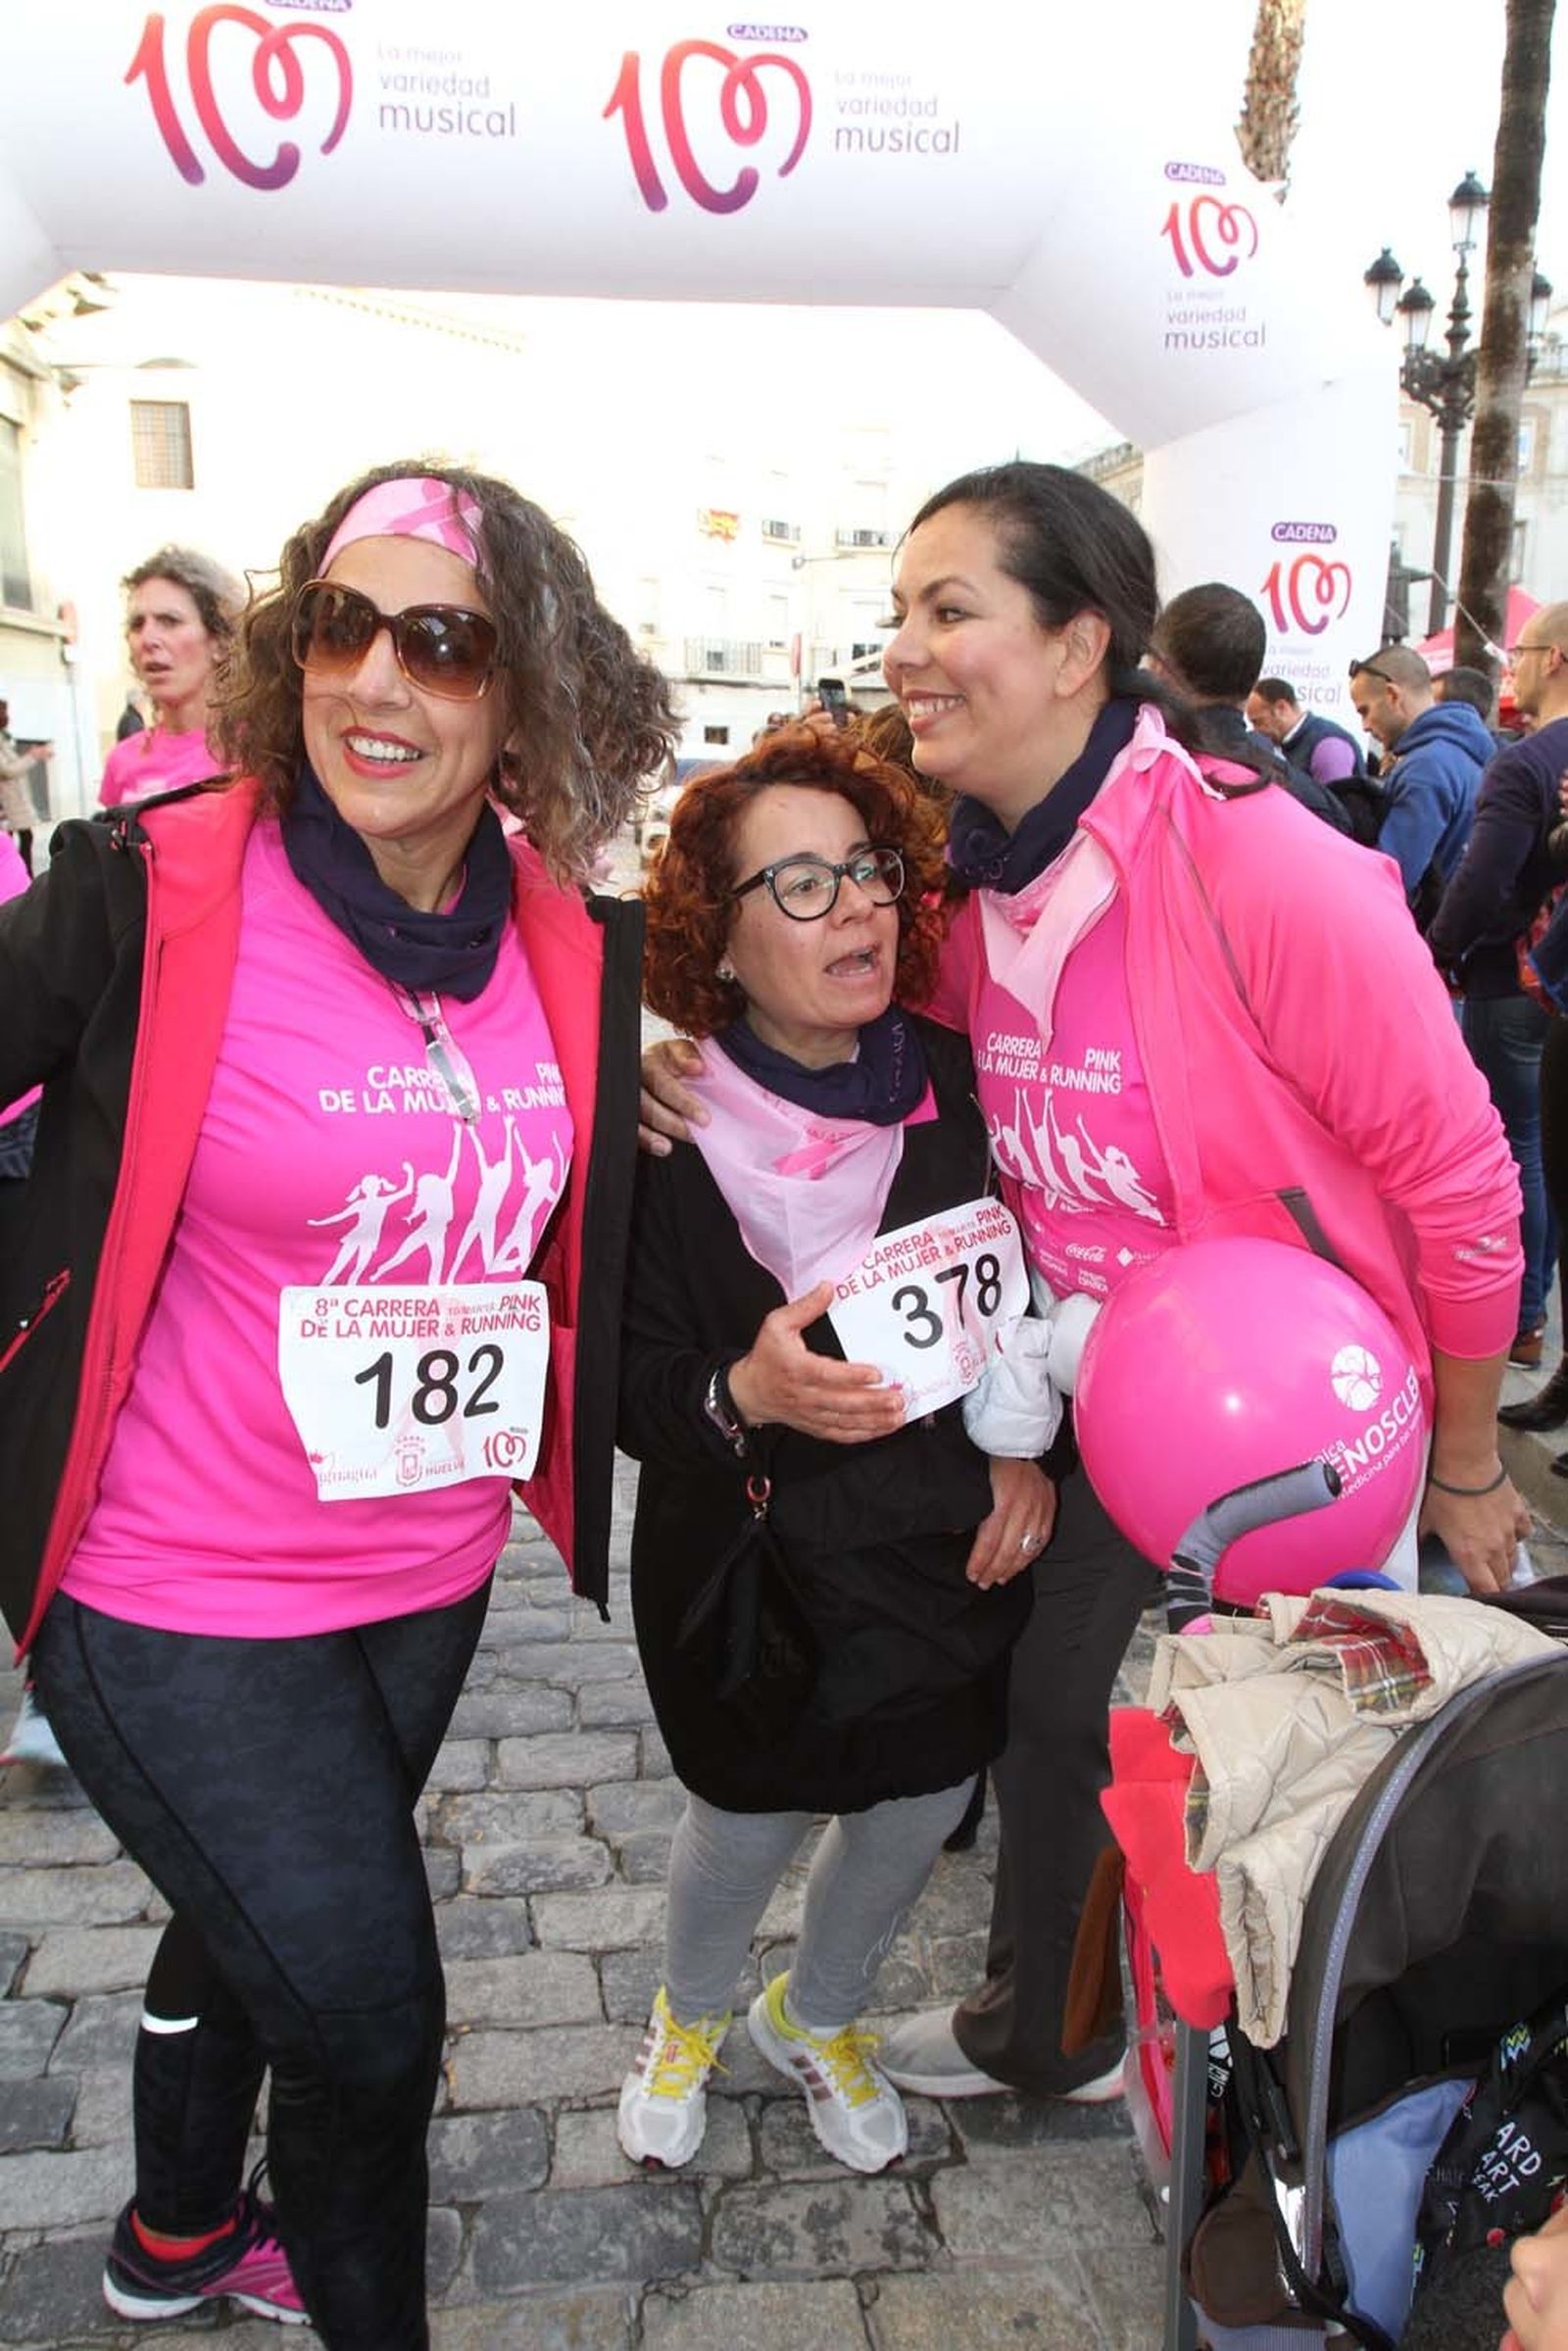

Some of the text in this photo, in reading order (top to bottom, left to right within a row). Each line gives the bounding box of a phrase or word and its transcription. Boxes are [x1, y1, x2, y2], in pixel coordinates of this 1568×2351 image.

[729, 24, 806, 41] CADENA
[379, 71, 491, 98] variedad
[838, 94, 938, 118] variedad
[378, 102, 516, 137] musical
[835, 120, 959, 154] musical
[1167, 307, 1247, 324] variedad
[1164, 321, 1266, 350] musical
[1273, 523, 1336, 543] CADENA
[1296, 684, 1342, 704] sical
[987, 1033, 1042, 1059] CARRERA
[1084, 1048, 1121, 1072] PINK
[535, 1062, 564, 1086] PIN
[995, 1054, 1040, 1082] MUJER
[1051, 1064, 1121, 1095] RUNNING
[318, 1089, 357, 1113] DE
[363, 1090, 396, 1114] LA
[486, 1096, 501, 1112] &
[975, 1205, 1005, 1225] PINK
[836, 1278, 860, 1300] DE
[862, 1271, 883, 1289] LA
[888, 1248, 941, 1280] MUJER
[954, 1220, 1012, 1250] RUNNING
[861, 1231, 935, 1270] CARRERA
[344, 1298, 440, 1318] CARRERA
[500, 1295, 541, 1313] PINK
[892, 1252, 1002, 1349] 378
[301, 1319, 328, 1339] DE
[335, 1320, 362, 1339] LA
[369, 1319, 439, 1339] MUJER
[461, 1312, 541, 1336] RUNNING
[354, 1344, 505, 1430] 182
[1472, 2173, 1499, 2204] EAK
